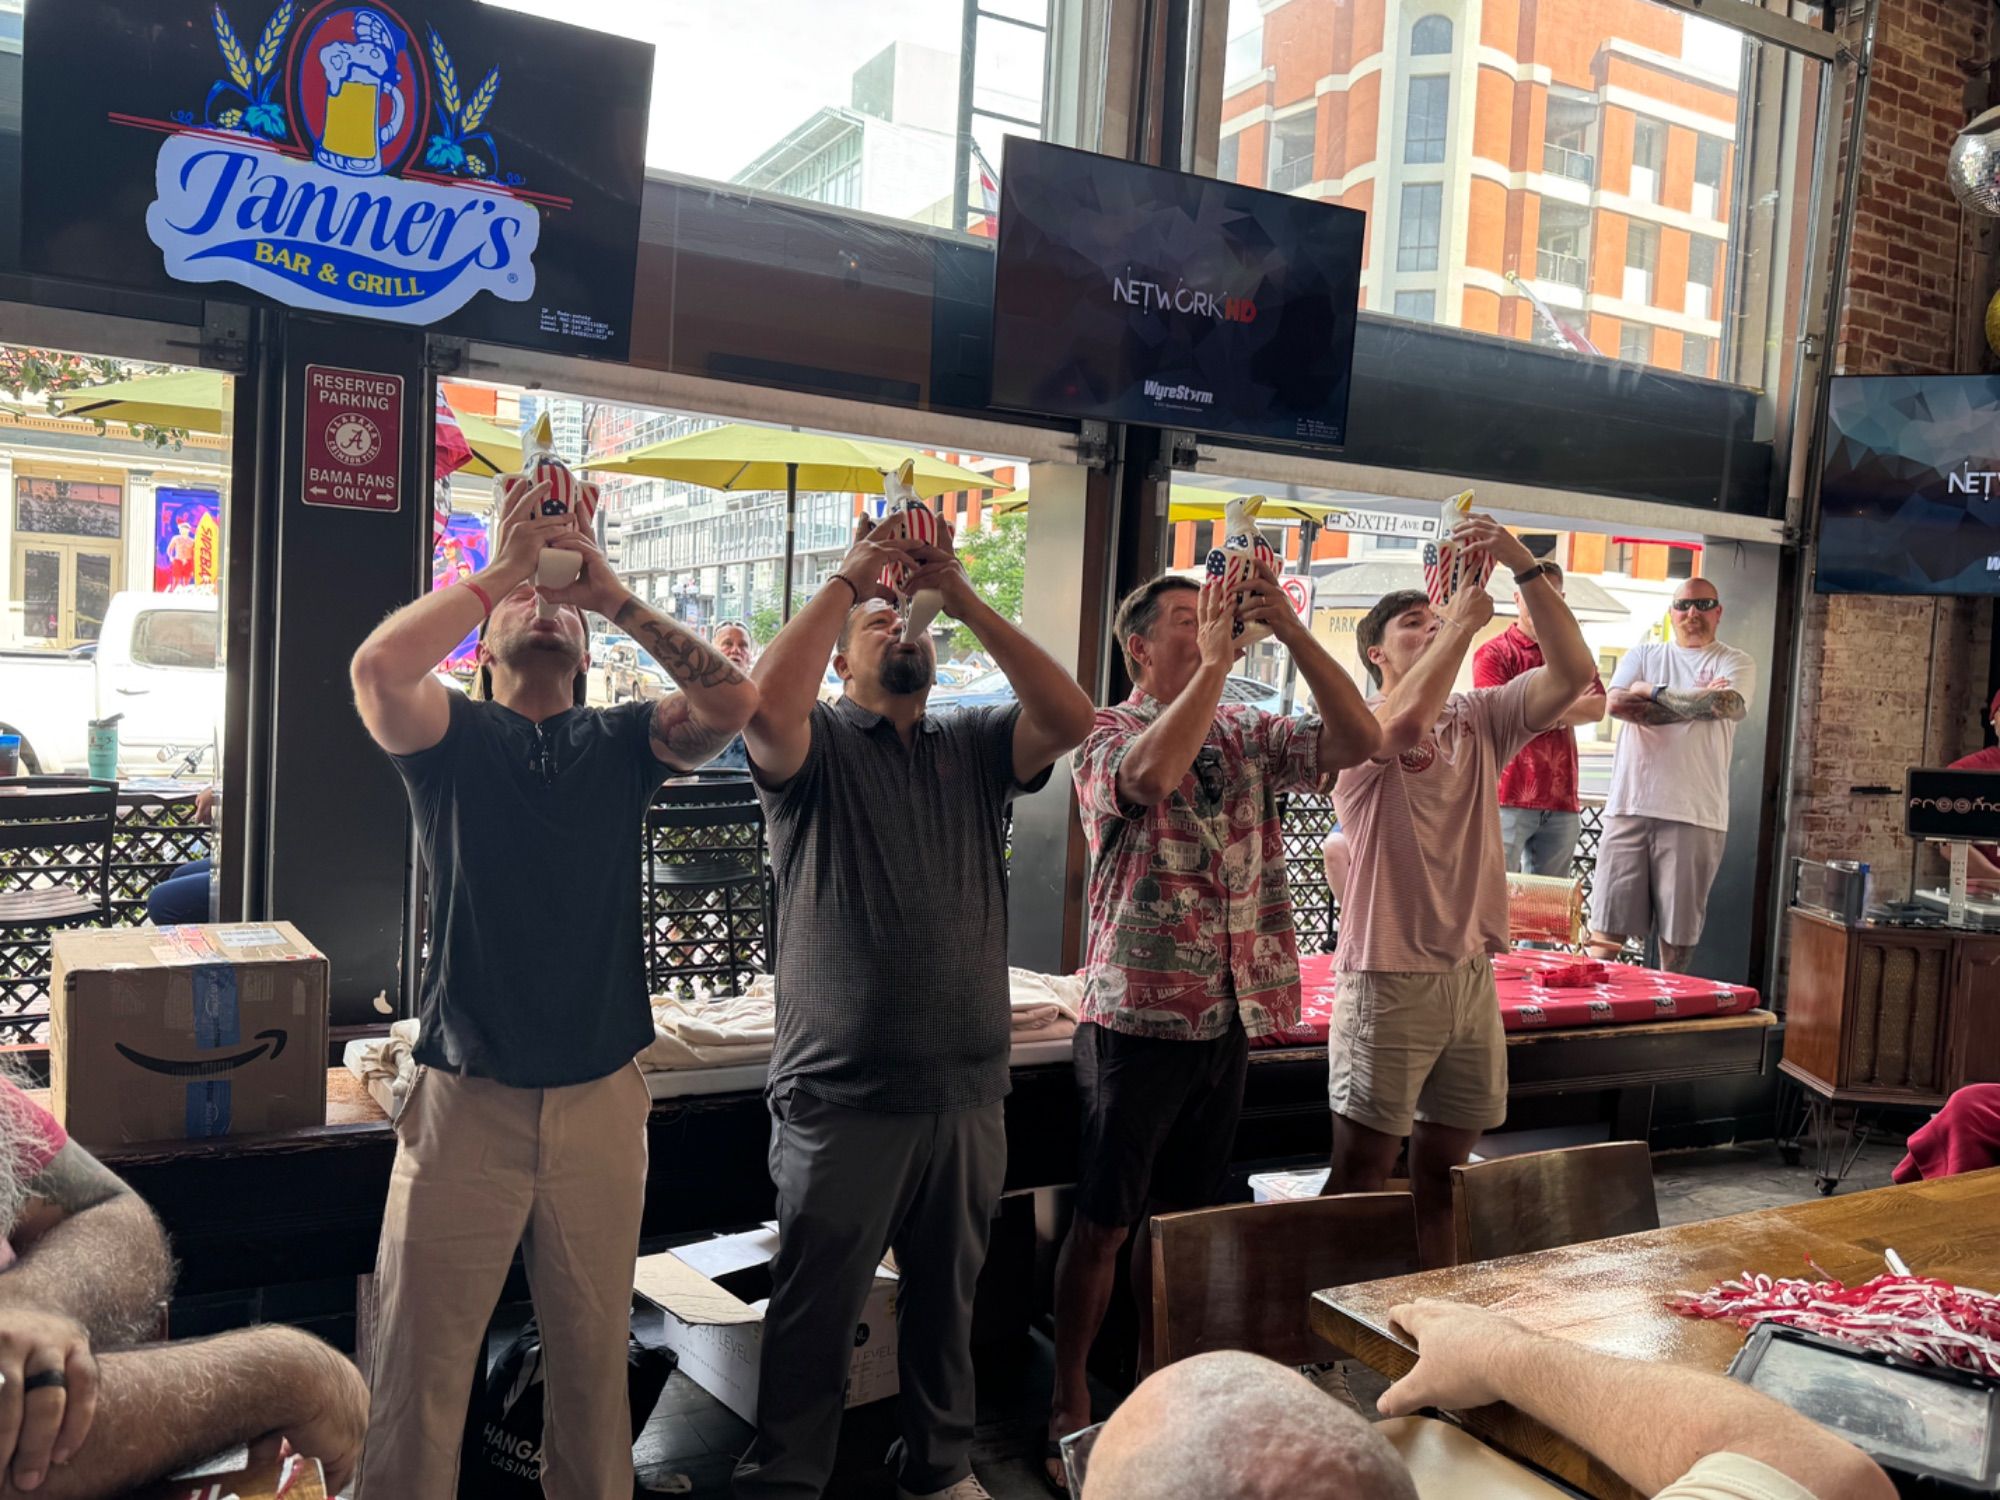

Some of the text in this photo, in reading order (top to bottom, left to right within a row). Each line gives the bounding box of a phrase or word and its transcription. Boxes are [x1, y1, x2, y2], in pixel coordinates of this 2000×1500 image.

[165, 149, 521, 270] Tanner's
[254, 241, 426, 297] BAR & GRILL
[312, 373, 397, 396] RESERVED
[319, 390, 389, 411] PARKING
[329, 414, 378, 440] ALABAMA
[328, 440, 361, 465] CRIMSON
[309, 467, 395, 489] BAMA FANS
[1947, 461, 2000, 501] NET
[332, 485, 372, 501] ONLY
[1345, 509, 1398, 532] SIXTH
[719, 1328, 752, 1366] LEVEL
[490, 1452, 540, 1480] CASINO
